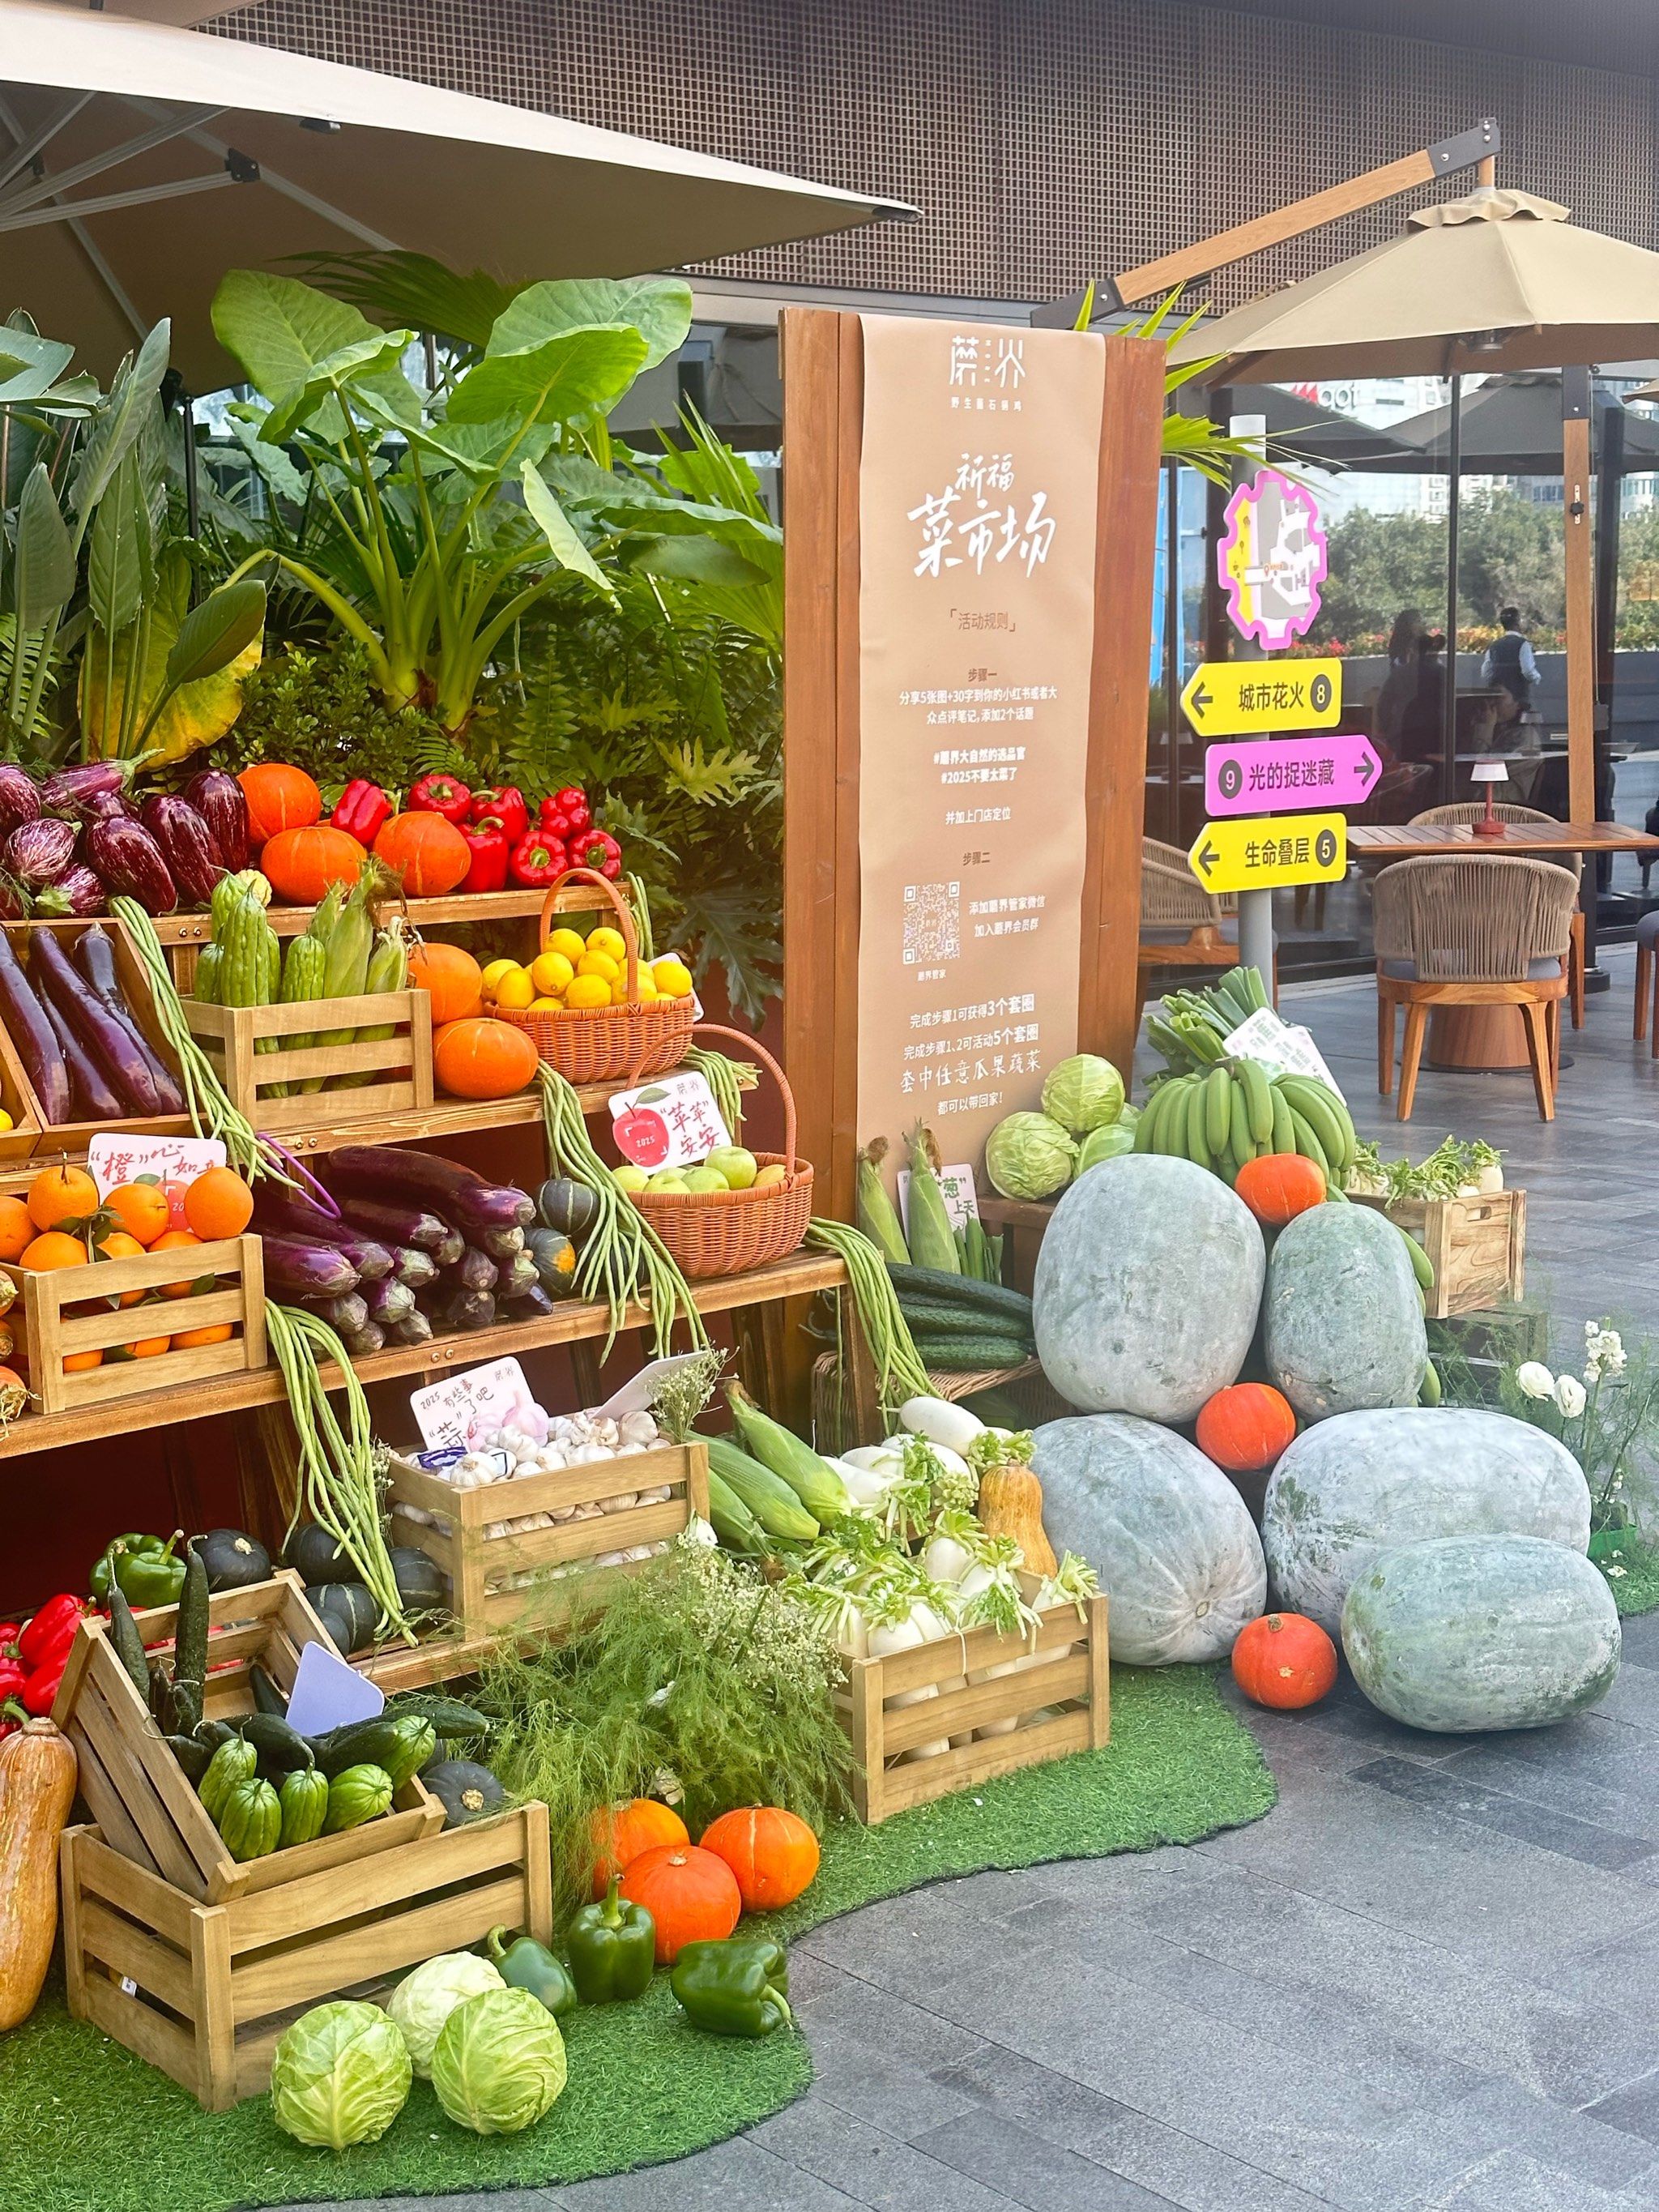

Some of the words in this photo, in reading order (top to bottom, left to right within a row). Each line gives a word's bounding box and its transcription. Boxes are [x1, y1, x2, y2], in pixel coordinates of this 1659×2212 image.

[955, 453, 1015, 499] 祈福
[906, 485, 1056, 578] 菜市场
[968, 668, 997, 682] 步骤一
[899, 686, 1057, 706] 分享5张图+30字到你的小红书或者大
[1239, 681, 1304, 712] 城市花火
[941, 767, 1017, 784] #2025不要太菜了
[1248, 758, 1334, 792] 光的捉迷藏
[945, 807, 1011, 825] 并加上门店定位
[962, 852, 990, 866] 步骤二
[1244, 838, 1310, 869] 生命叠层
[910, 993, 1034, 1029] 完成步骤1可获得3个套圈
[903, 1023, 1039, 1061] 完成步骤1、2可活动5个套圈
[900, 1048, 1041, 1093] 套中任意瓜果蔬菜
[635, 1135, 655, 1148] 2025
[420, 1391, 441, 1410] 2025
